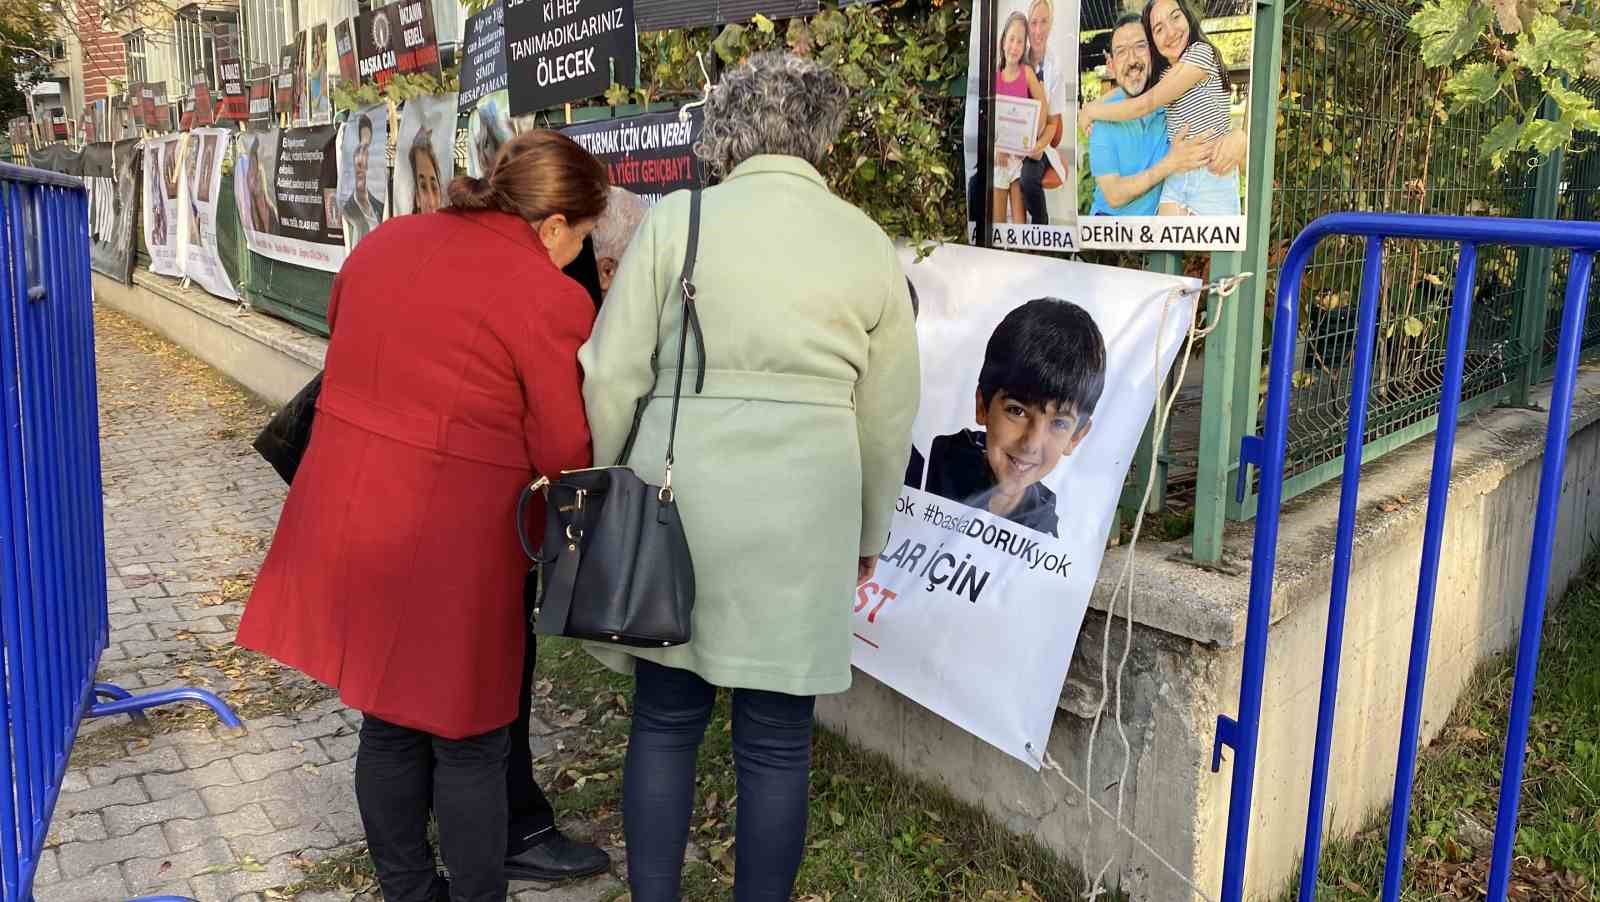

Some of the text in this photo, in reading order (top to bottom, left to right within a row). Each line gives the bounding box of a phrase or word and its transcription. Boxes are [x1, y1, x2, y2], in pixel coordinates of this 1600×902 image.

[556, 0, 581, 18] HEP
[509, 7, 625, 61] TANIMADIKLARINIZ
[359, 53, 383, 80] BAŞKA
[475, 58, 496, 84] ŞİMDİ
[536, 46, 596, 87] ÖLECEK
[459, 85, 481, 107] HESAP
[619, 121, 640, 157] İÇİN
[640, 125, 661, 150] CAN
[660, 119, 693, 147] VEREN
[615, 156, 640, 185] YİĞİT
[1006, 228, 1018, 245] &
[1022, 226, 1074, 249] KÜBRA
[1081, 221, 1241, 245] DERİN & ATAKAN
[919, 541, 991, 604] İÇİN
